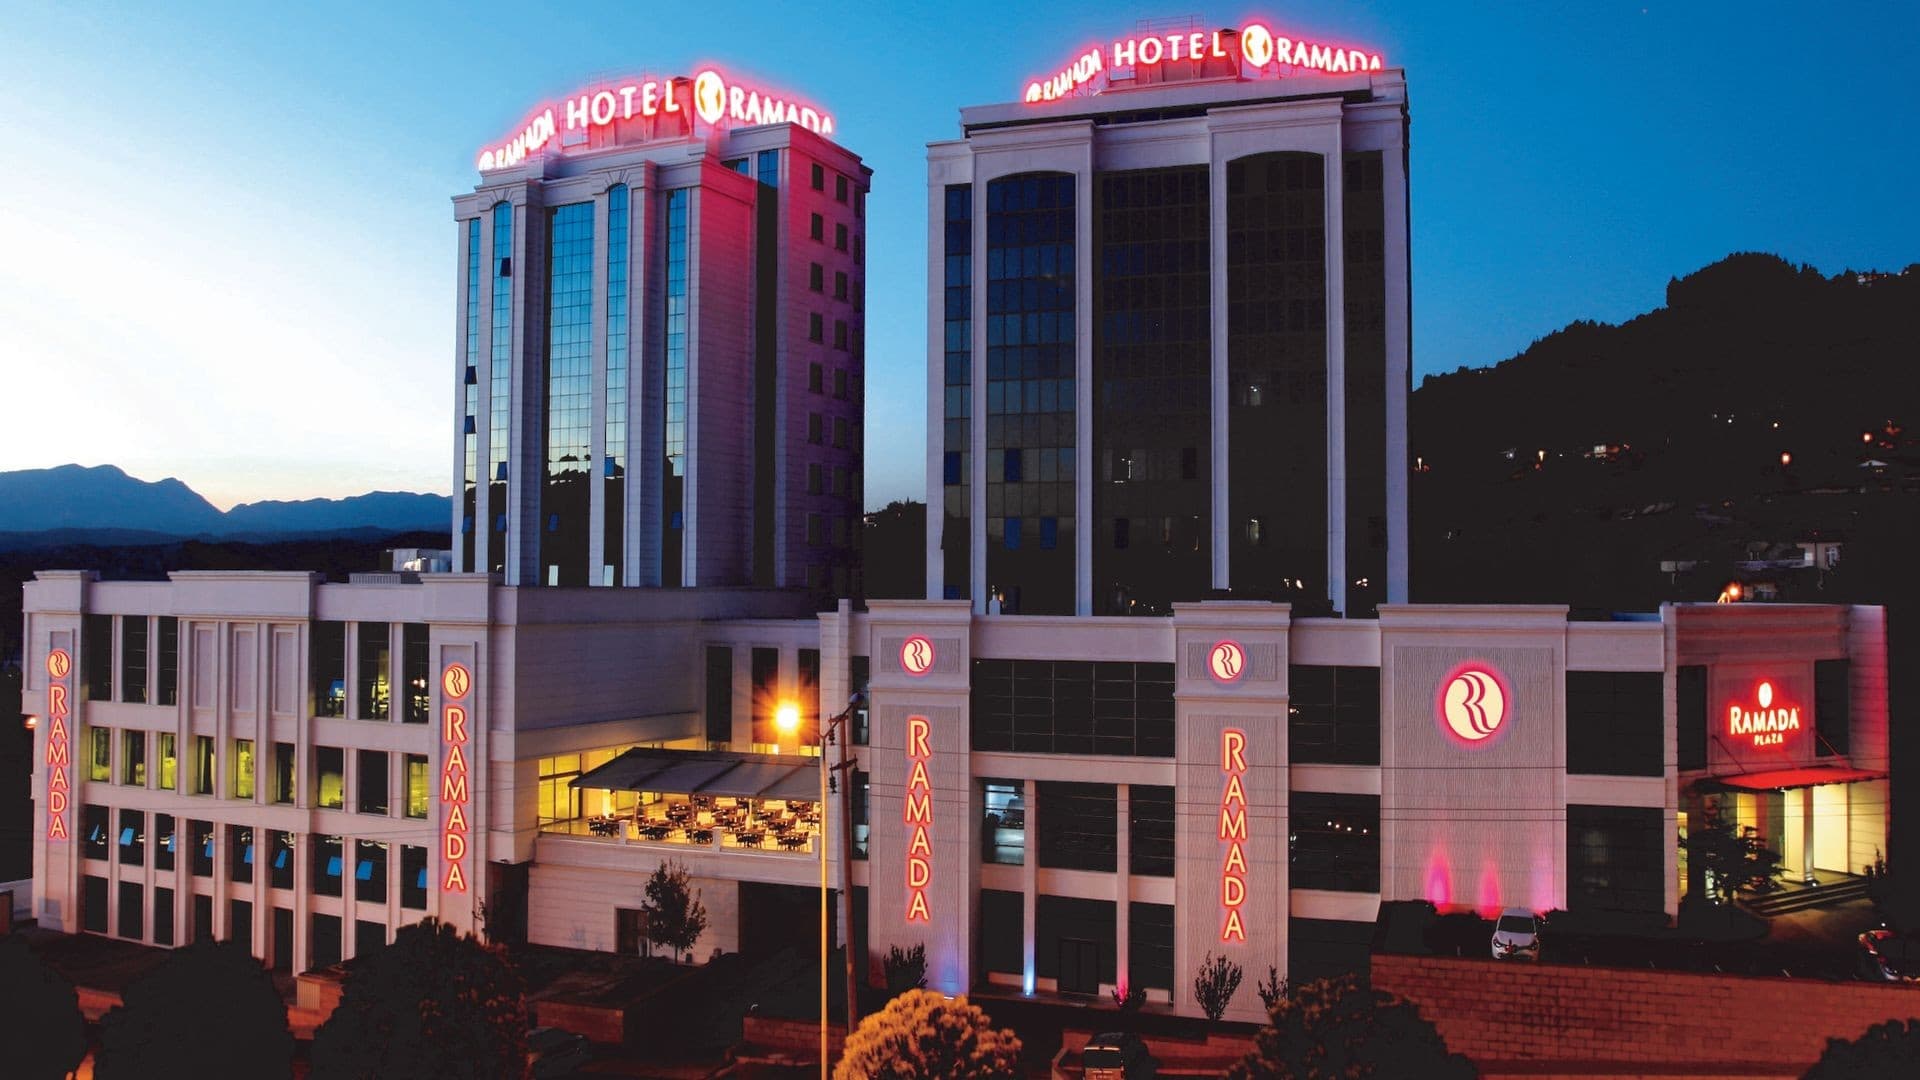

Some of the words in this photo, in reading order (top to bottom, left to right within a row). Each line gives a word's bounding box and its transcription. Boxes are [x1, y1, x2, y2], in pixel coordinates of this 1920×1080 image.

[495, 108, 555, 169] RAMADA
[567, 79, 679, 130] HOTEL
[730, 86, 832, 134] RAMADA
[1043, 48, 1102, 101] RAMADA
[1114, 32, 1226, 67] HOTEL
[1277, 37, 1381, 72] RAMADA
[49, 685, 69, 839] RAMADA
[1730, 706, 1799, 735] RAMADA
[1753, 733, 1783, 746] PLAZA
[443, 707, 468, 891] RAMADA
[905, 719, 932, 921] RAMADA
[1220, 732, 1247, 940] RAMADA
